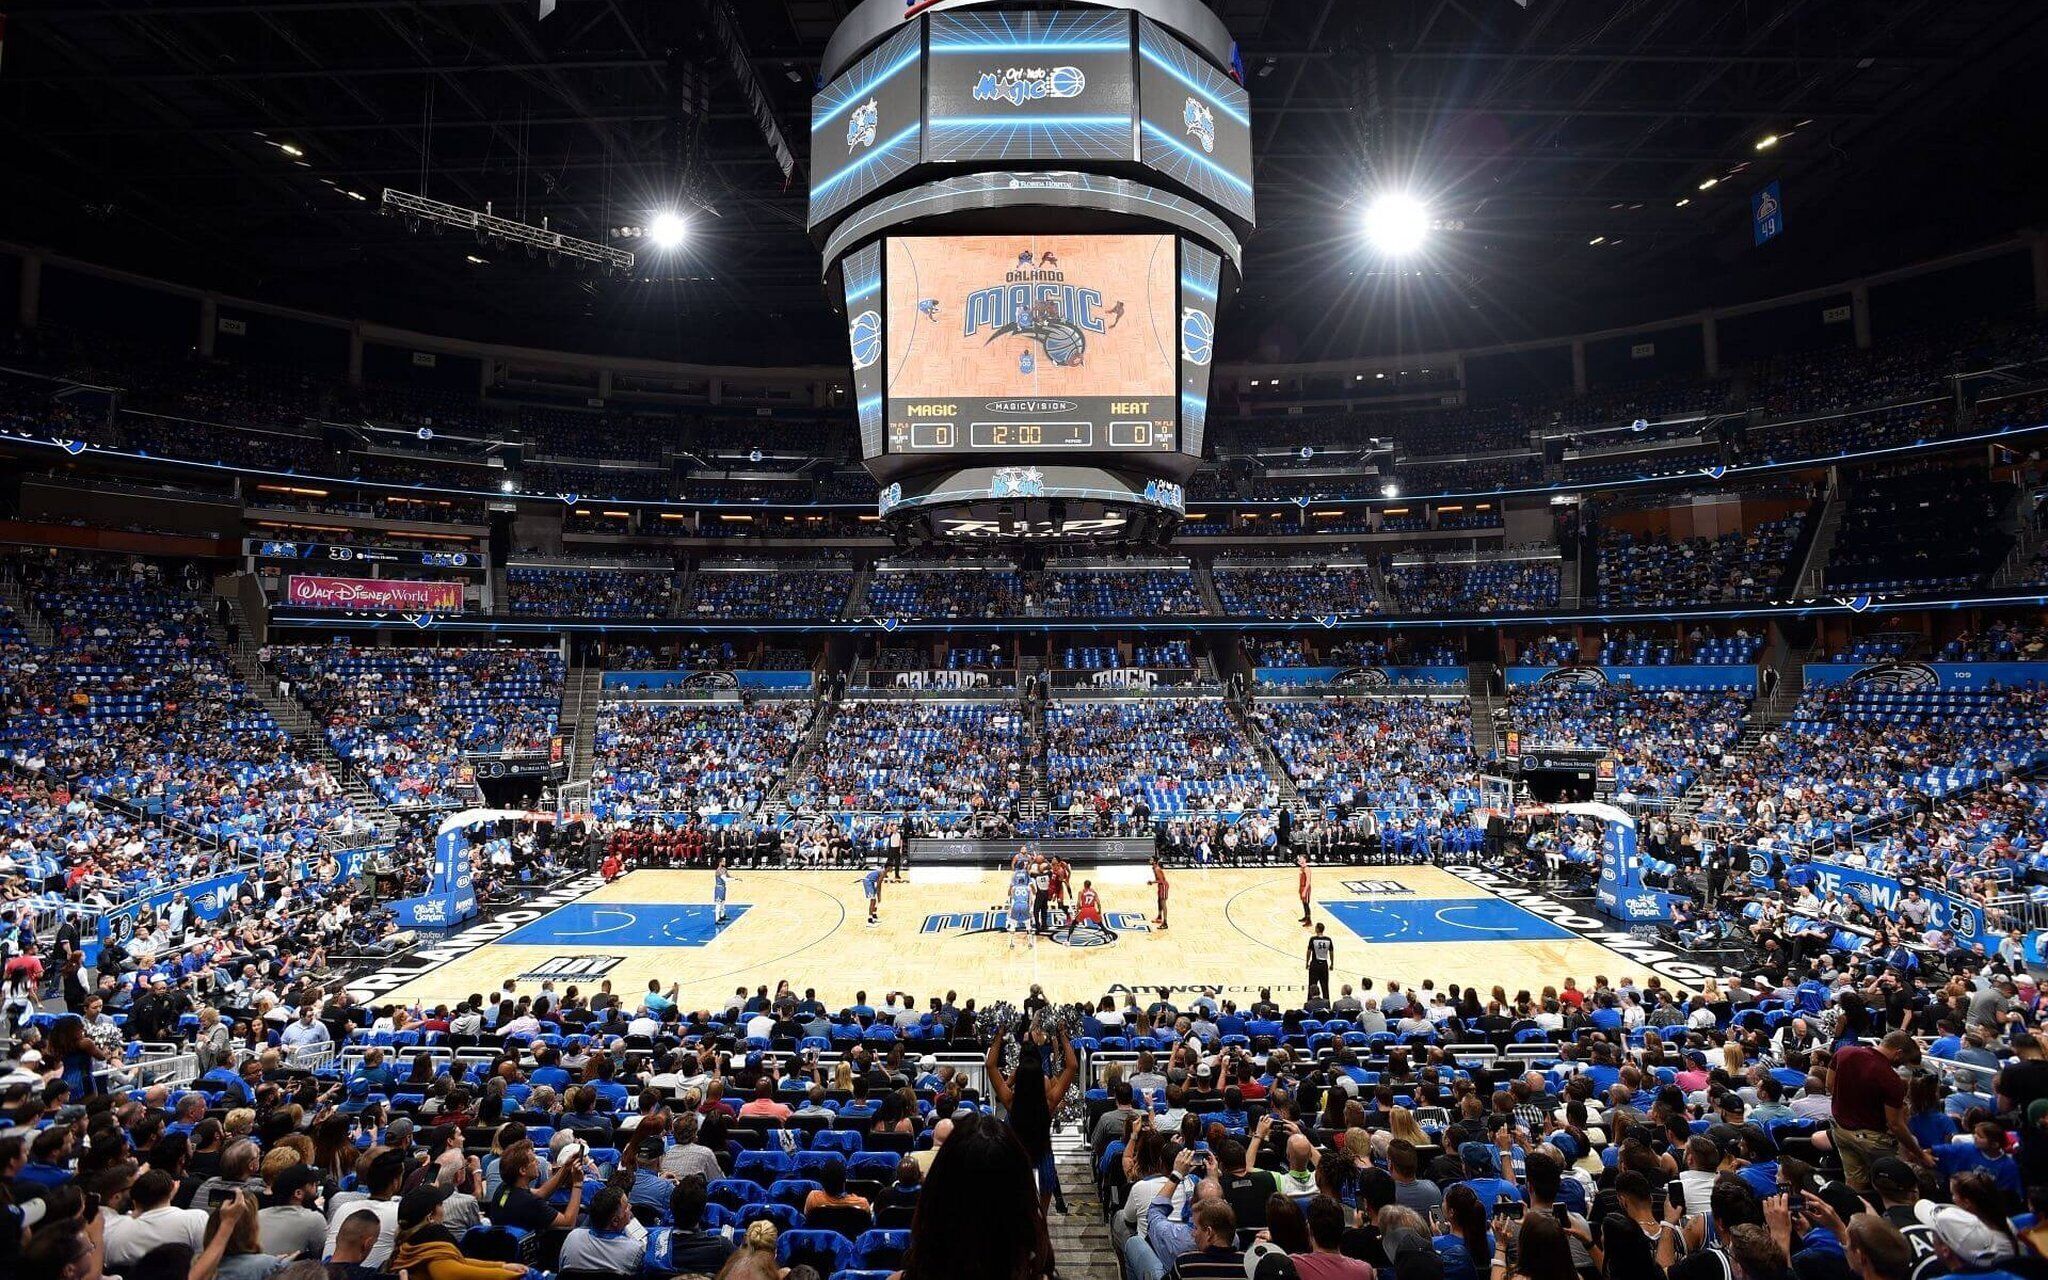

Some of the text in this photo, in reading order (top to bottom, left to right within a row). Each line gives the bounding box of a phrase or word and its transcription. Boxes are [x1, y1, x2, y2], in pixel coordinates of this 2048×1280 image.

[1761, 217, 1776, 237] 49
[1005, 269, 1065, 282] ORLANDO
[963, 283, 1106, 338] MAGIC
[907, 404, 958, 417] MAGIC
[995, 401, 1067, 413] MAGICVISION
[1110, 402, 1150, 415] HEAT
[936, 427, 948, 445] 0
[993, 426, 1041, 445] 12:00
[1134, 426, 1146, 444] 0
[297, 580, 429, 606] WALT DISNEY World
[1443, 865, 1604, 929] ORLANDO
[1871, 882, 1945, 928] MAIC
[919, 910, 1151, 934] MAGC
[1107, 983, 1224, 995] Amway
